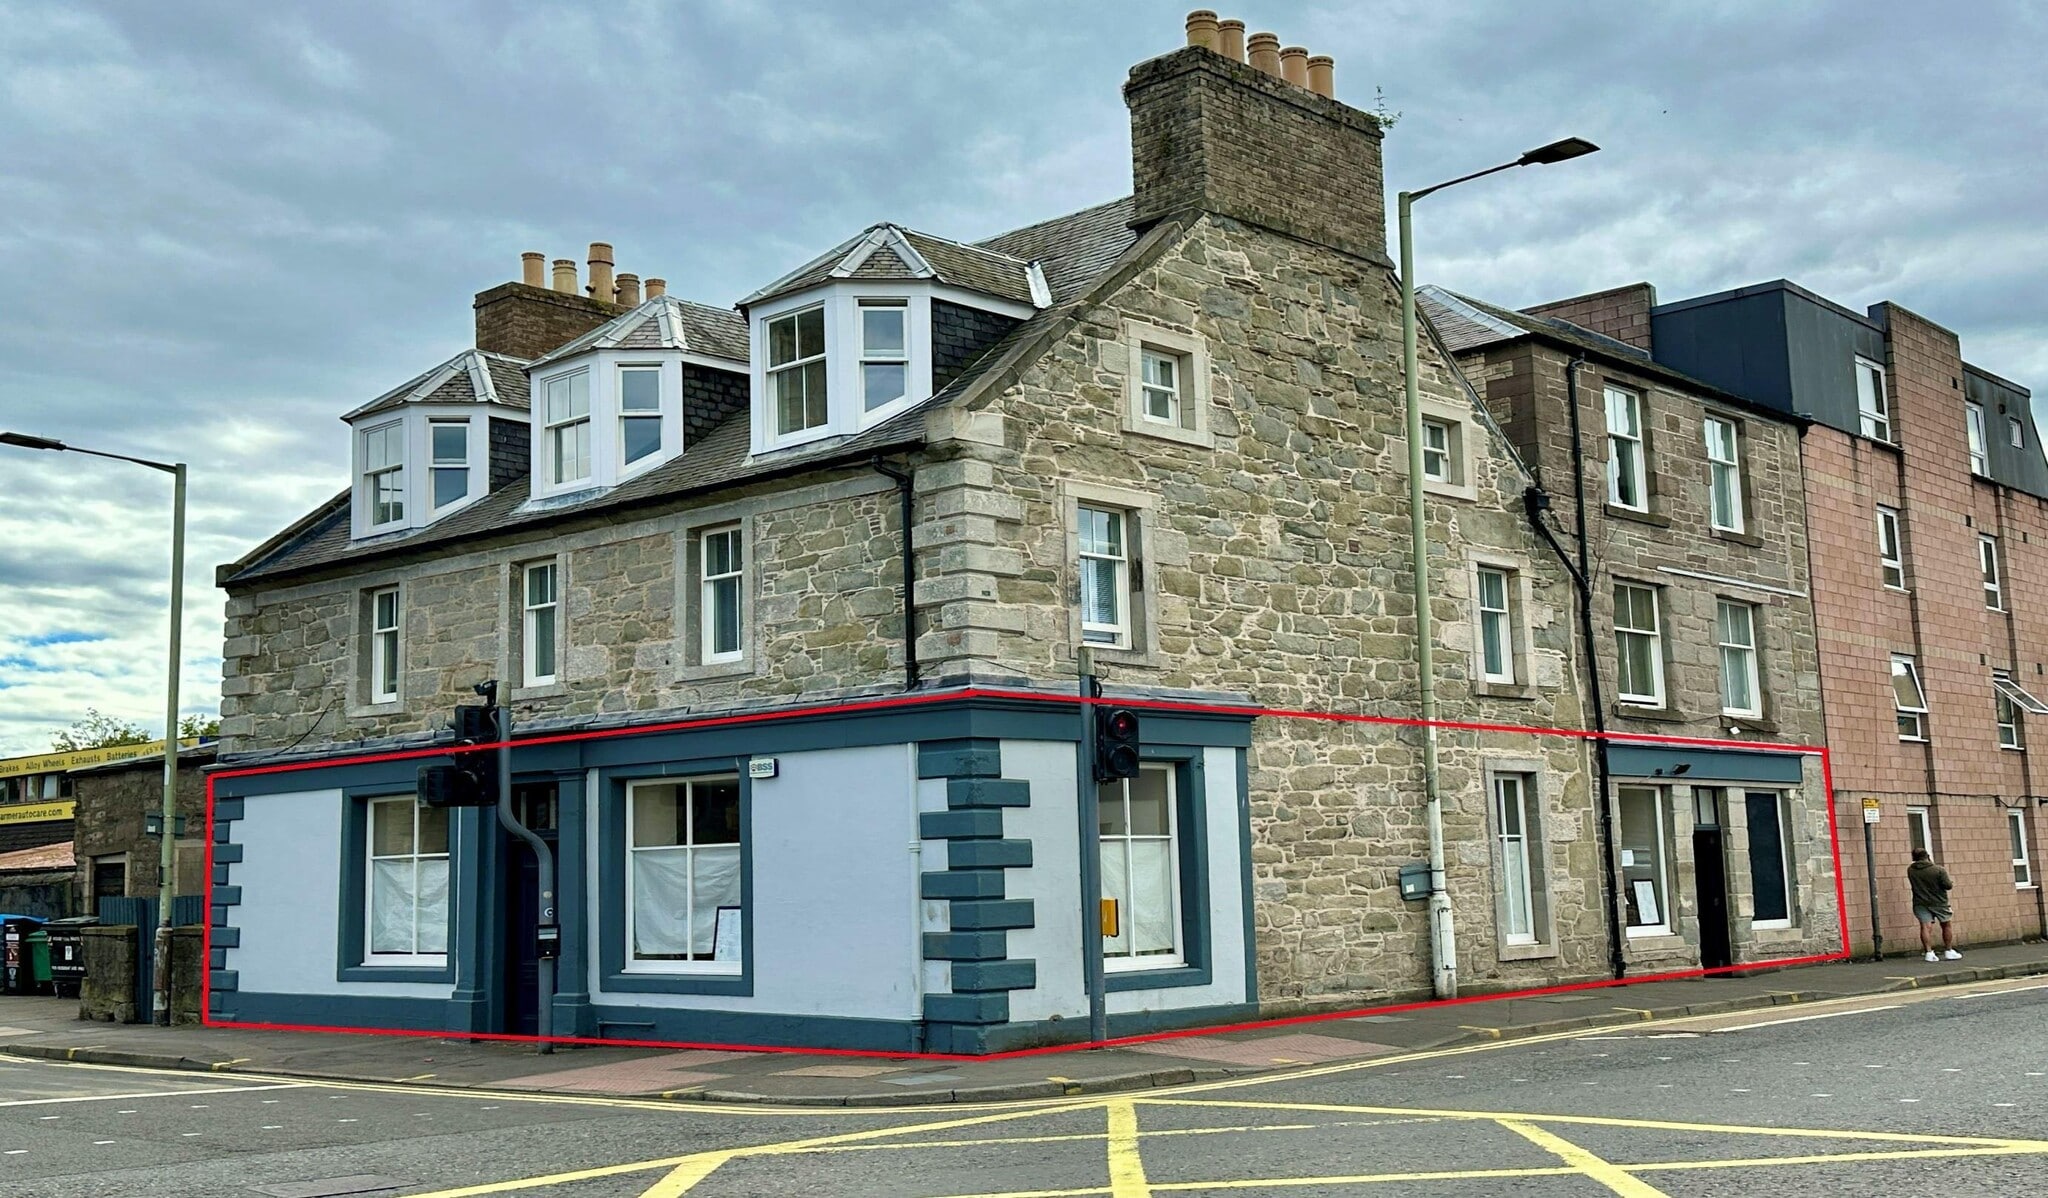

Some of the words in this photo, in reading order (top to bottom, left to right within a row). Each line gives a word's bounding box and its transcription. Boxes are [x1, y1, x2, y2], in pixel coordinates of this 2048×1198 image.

[25, 761, 41, 771] Alloy
[43, 759, 65, 768] Wheels
[71, 754, 101, 765] Exhausts
[106, 751, 137, 760] Batteries
